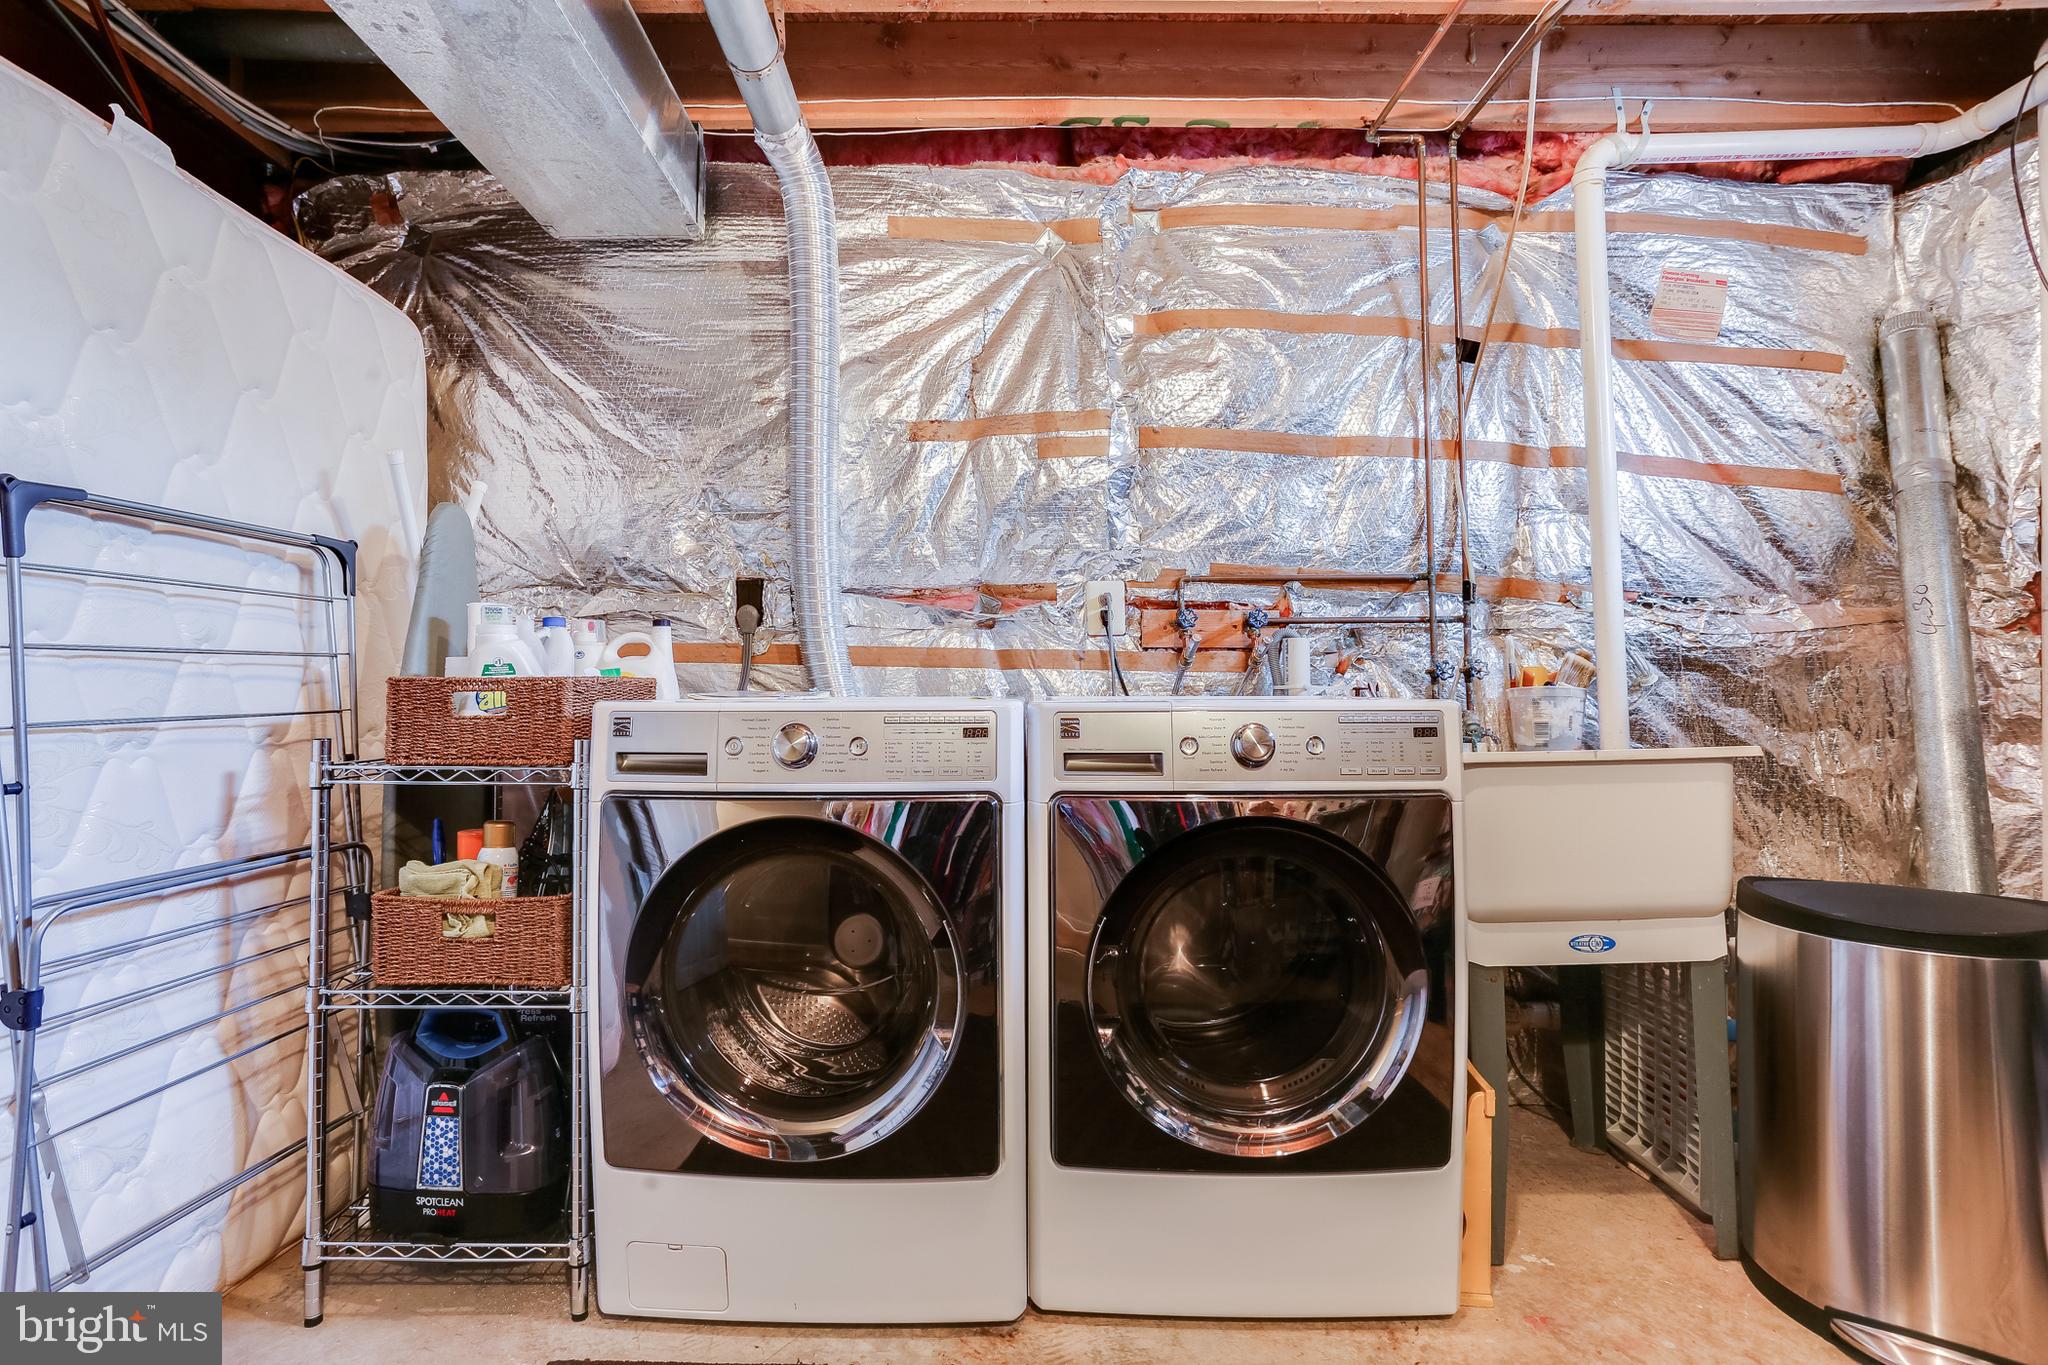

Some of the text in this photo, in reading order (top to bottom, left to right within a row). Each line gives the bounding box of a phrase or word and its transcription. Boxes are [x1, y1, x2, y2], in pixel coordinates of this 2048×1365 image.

[520, 1014, 557, 1022] Refresh
[416, 1196, 464, 1207] SPOTCLEAN
[422, 1208, 457, 1216] PROHEAT
